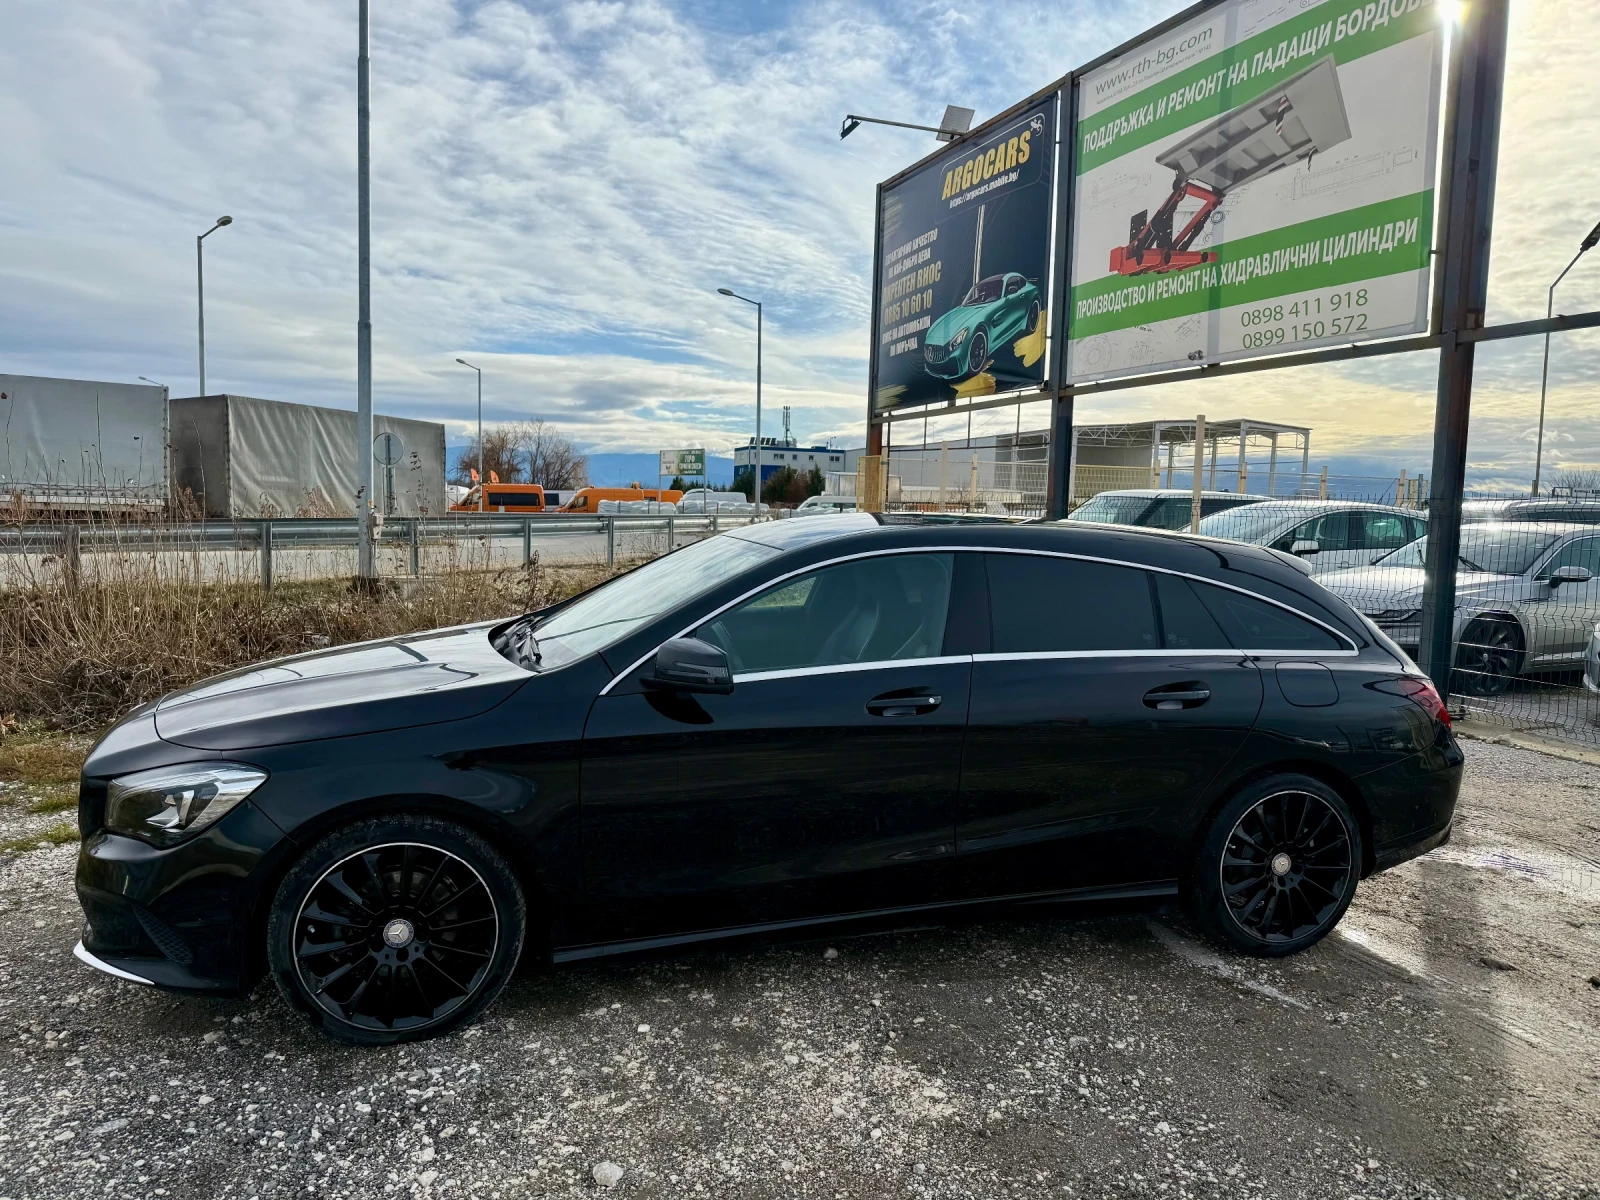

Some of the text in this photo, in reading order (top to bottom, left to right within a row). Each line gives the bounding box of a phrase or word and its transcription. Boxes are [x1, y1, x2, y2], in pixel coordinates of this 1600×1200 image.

[1083, 104, 1153, 154] ПОДДРЪЖКА
[1156, 95, 1167, 118] И
[1167, 69, 1227, 115] РЕМОНТ
[1226, 61, 1249, 88] НА
[1251, 20, 1333, 77] ПАДАЩИ
[1095, 27, 1213, 95] www.rth-bg.com
[941, 129, 1032, 201] ARGOCARS
[916, 260, 942, 289] ВНОС
[1076, 217, 1418, 320] ПРОИЗВОДСТВО И РЕМОНТ НА ХИДРАВЛИЧНИ ЦИЛИНДРИ
[901, 297, 911, 318] 10
[911, 293, 921, 316] 60
[922, 289, 933, 310] 10
[1241, 288, 1369, 328] 0898 411 918
[1242, 313, 1369, 350] 0899 150 572
